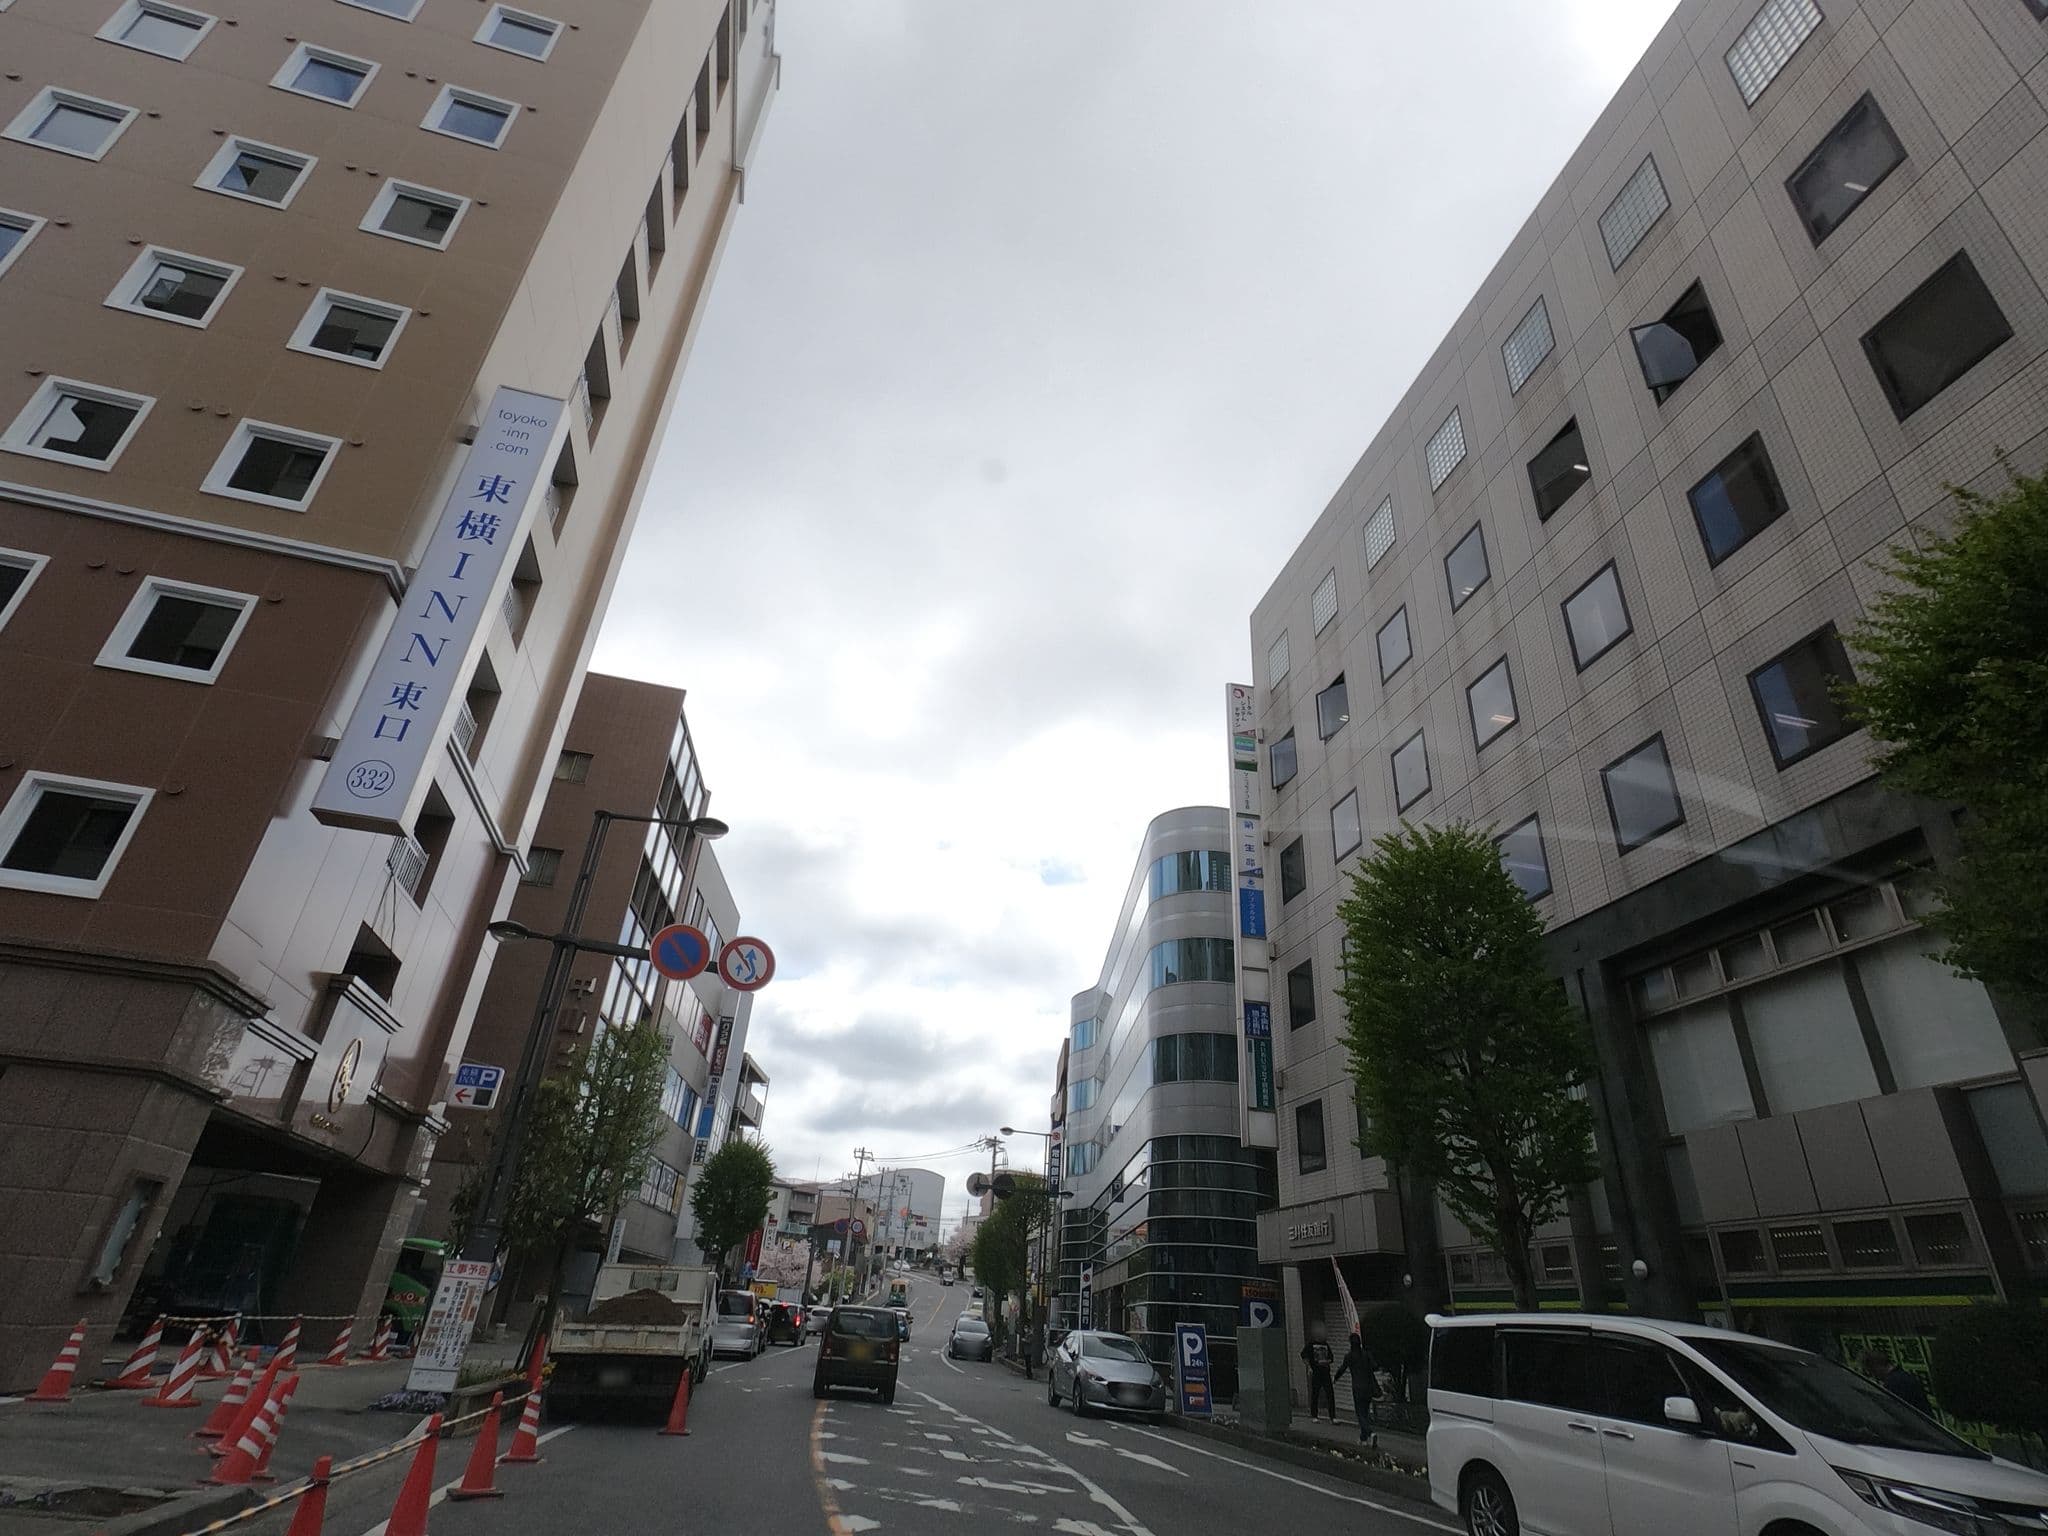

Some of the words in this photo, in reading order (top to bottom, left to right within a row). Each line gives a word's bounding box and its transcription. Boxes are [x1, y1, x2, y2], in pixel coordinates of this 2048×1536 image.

[499, 410, 548, 428] toyoko
[502, 429, 530, 441] -inn
[490, 442, 529, 456] .com
[351, 767, 389, 791] 332
[1244, 820, 1256, 867] 第一生命
[479, 1070, 497, 1085] P
[1287, 1220, 1328, 1241] 三井住友銀行
[1191, 1358, 1205, 1367] 24h
